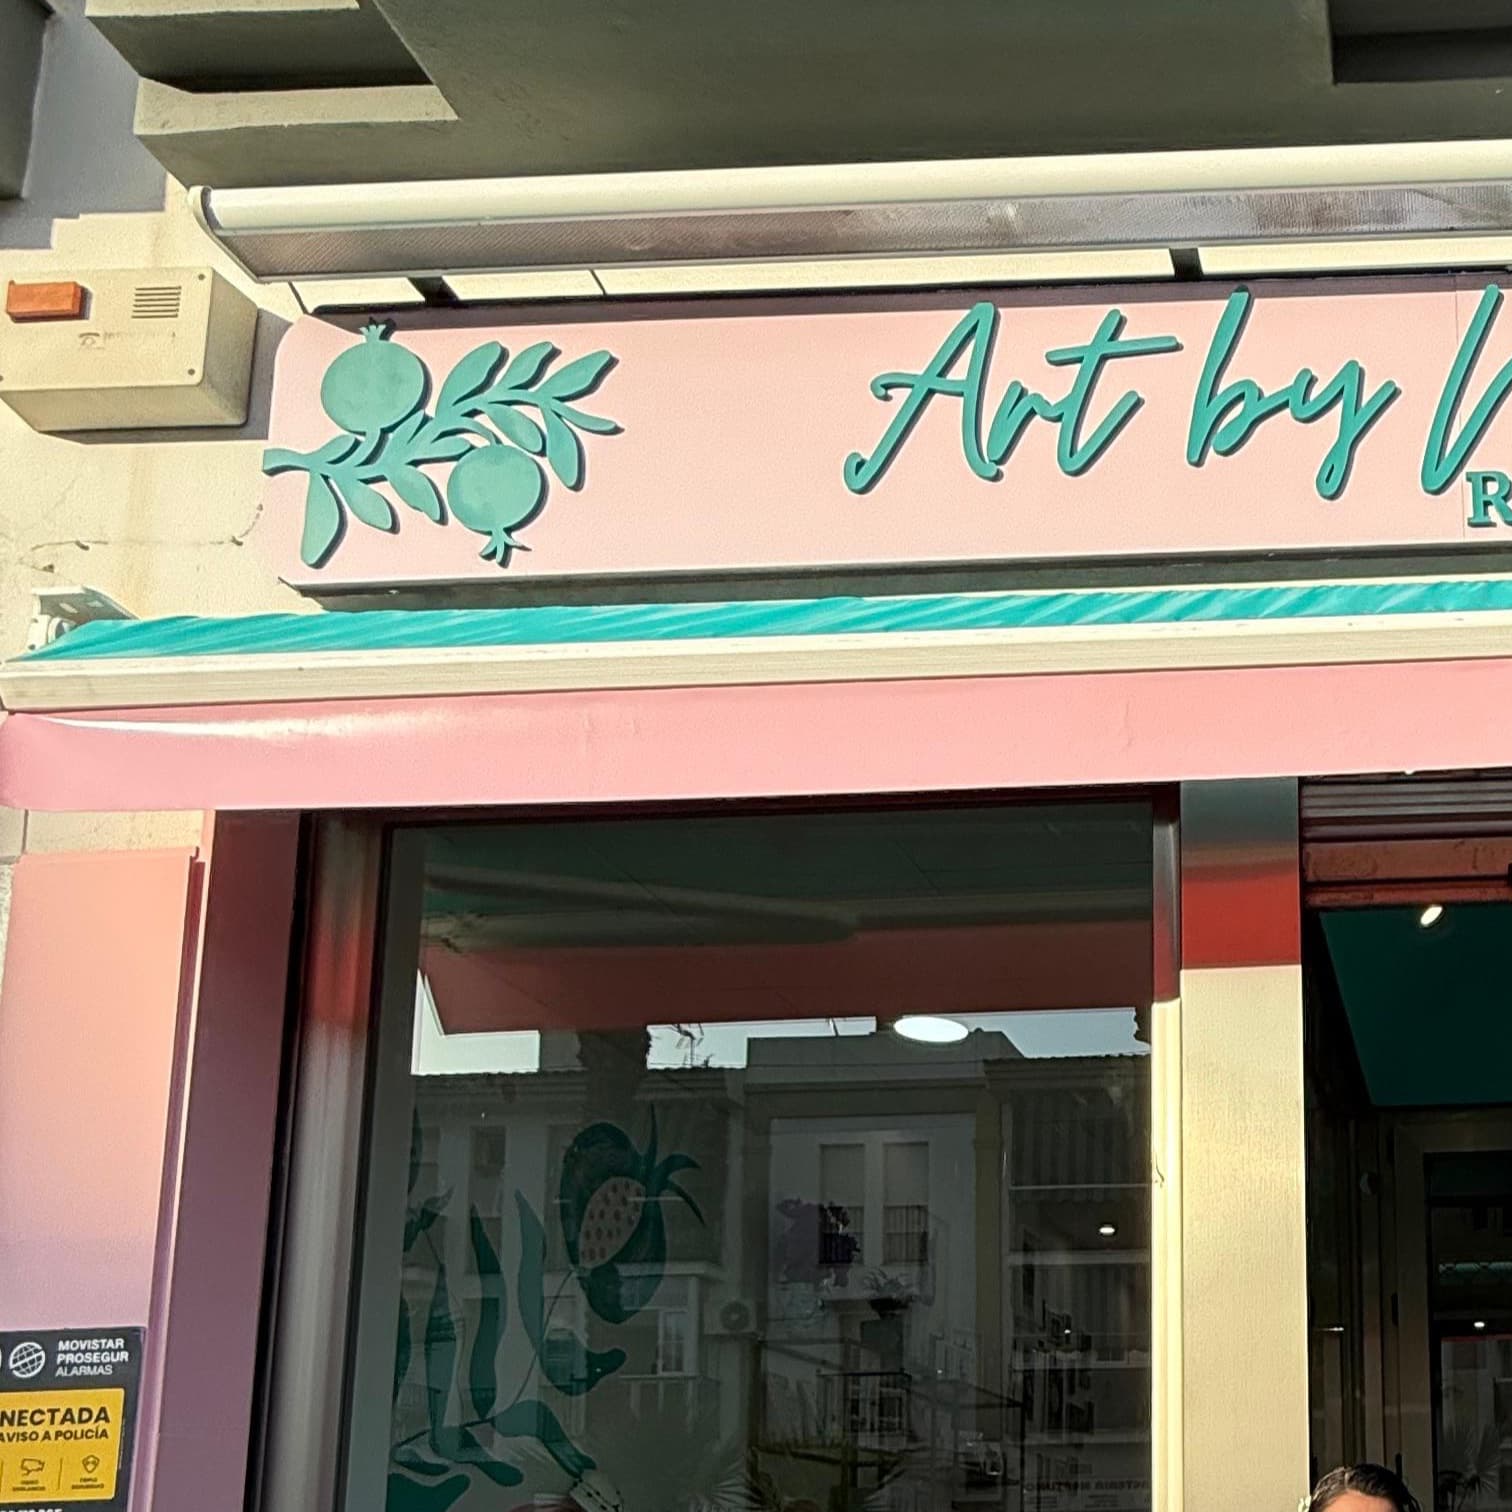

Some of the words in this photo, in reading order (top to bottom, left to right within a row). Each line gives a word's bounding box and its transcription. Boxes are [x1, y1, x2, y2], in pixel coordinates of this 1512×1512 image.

[844, 302, 1184, 495] Art
[1186, 285, 1403, 500] by
[57, 1338, 125, 1351] MOVISTAR
[56, 1351, 129, 1365] PROSEGUR
[54, 1364, 113, 1377] ALARMAS
[40, 1430, 52, 1441] A
[54, 1425, 109, 1441] POLICÍA
